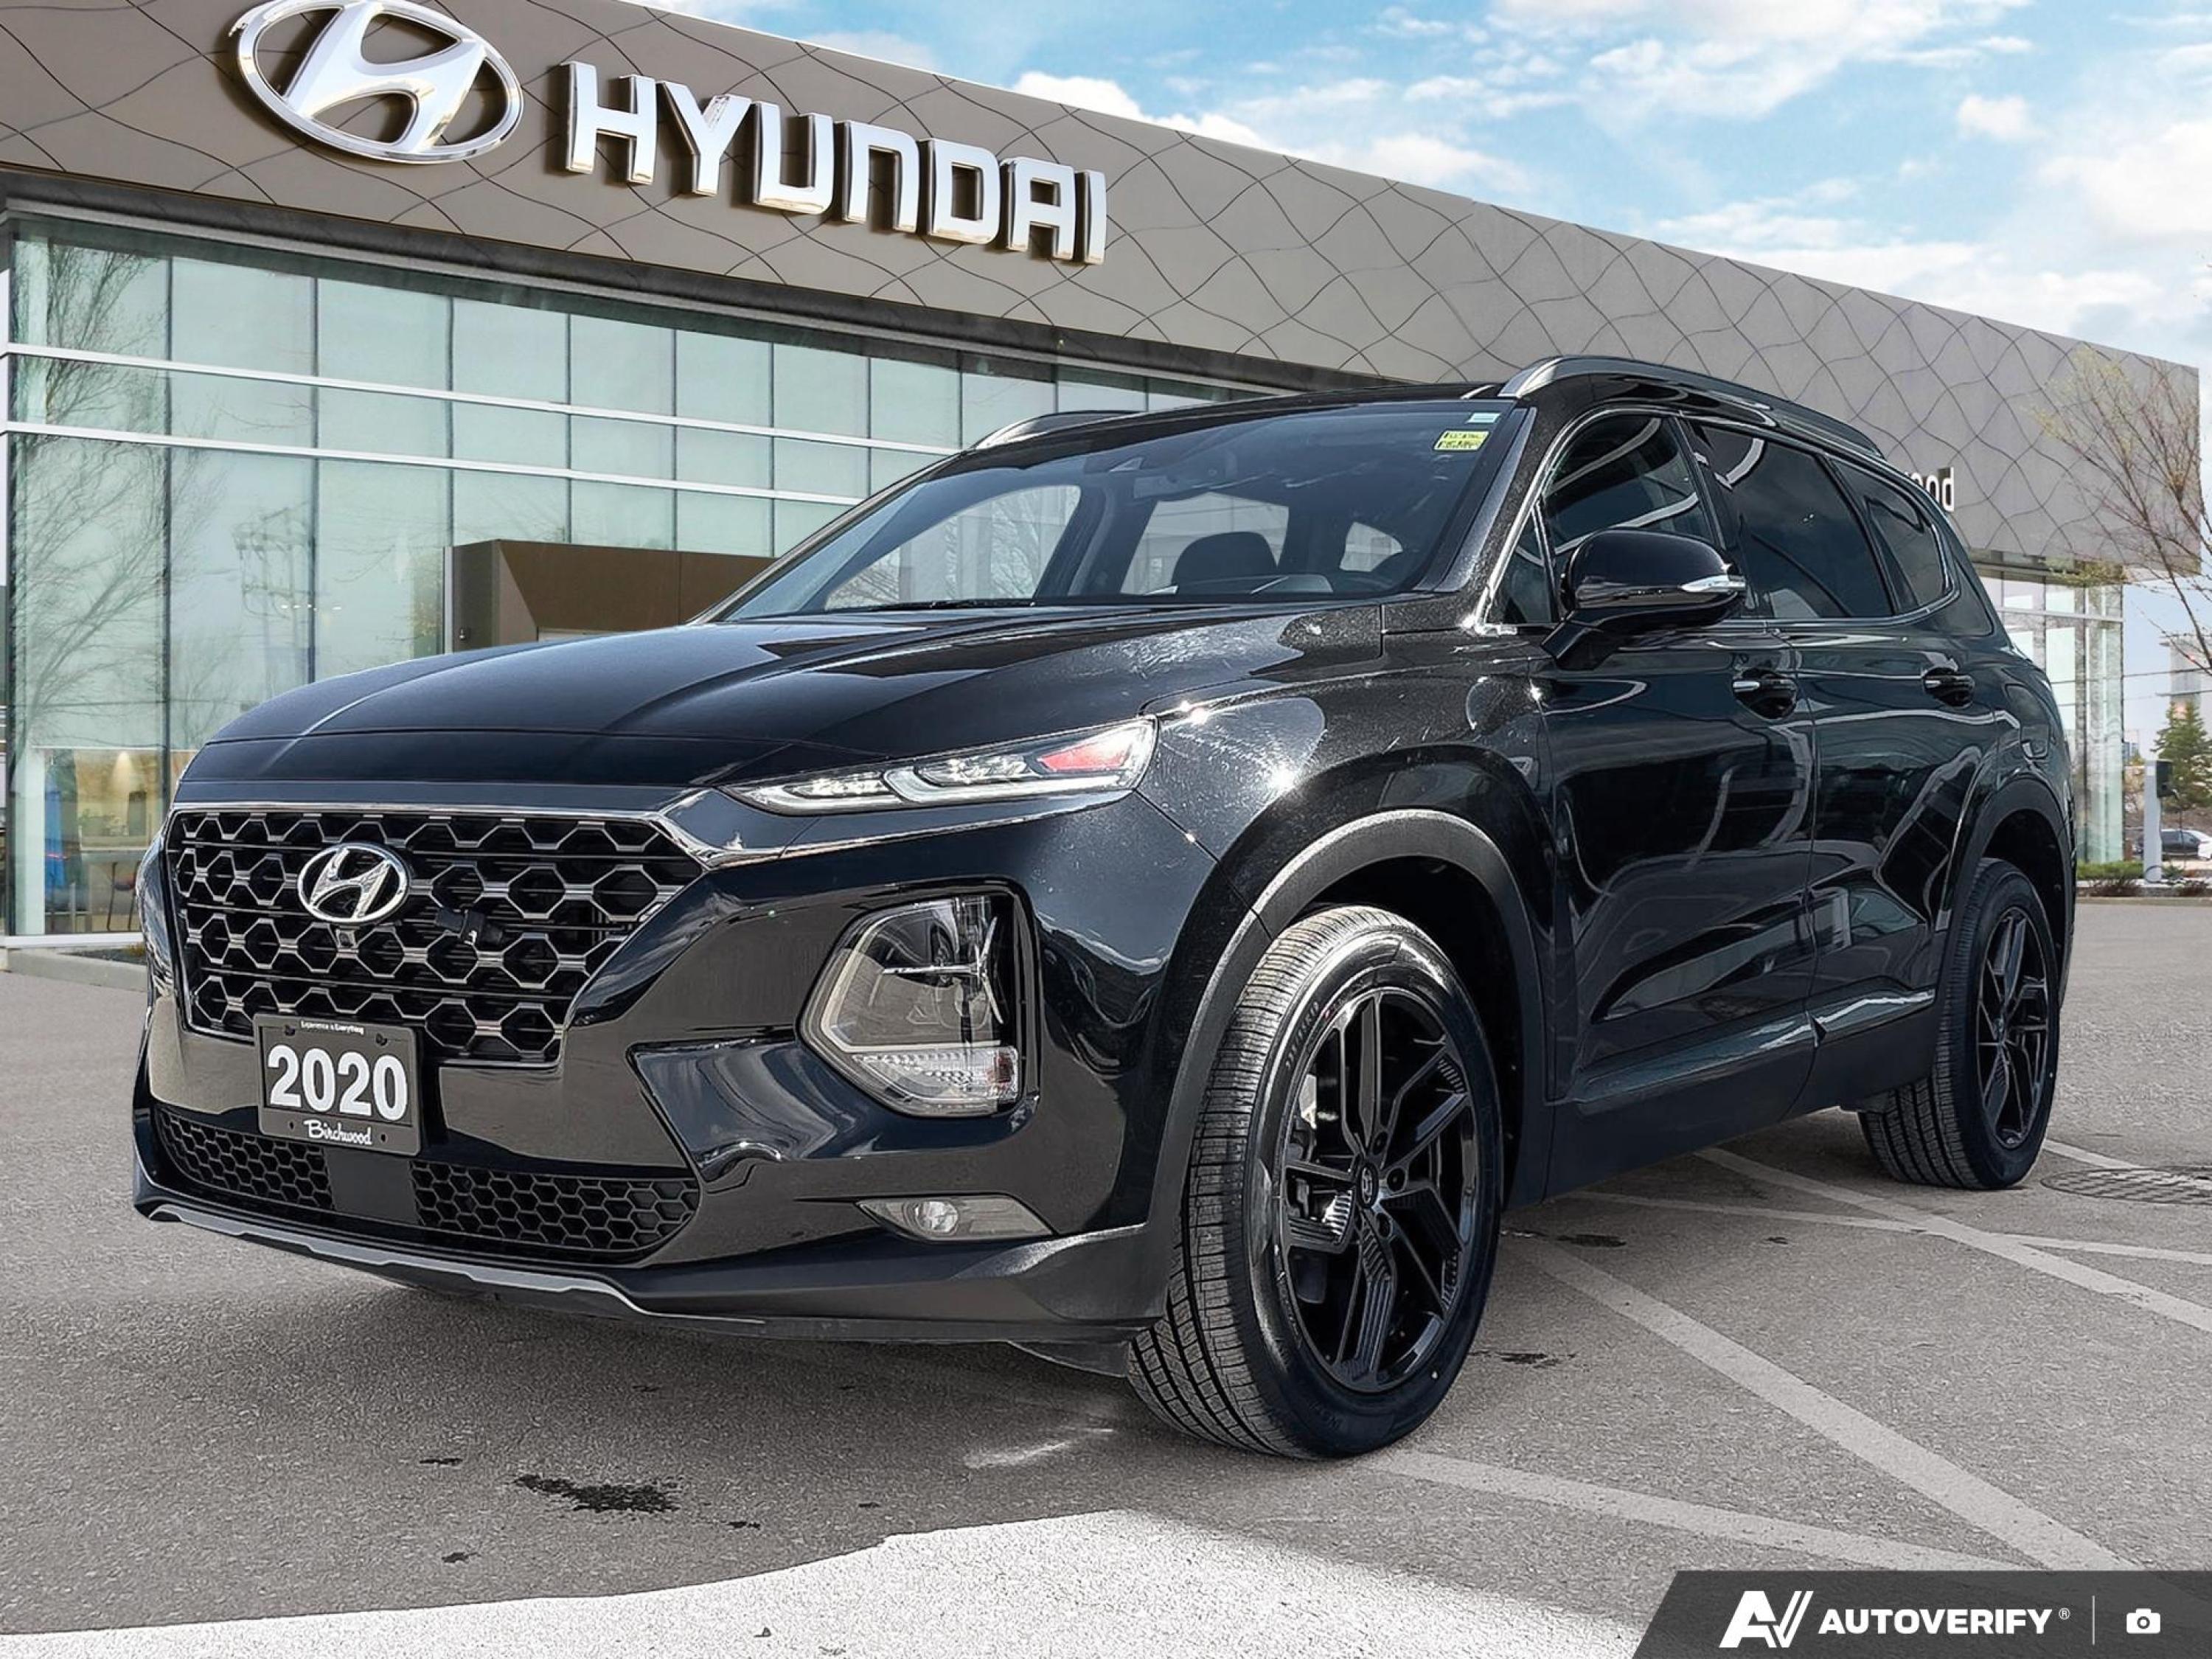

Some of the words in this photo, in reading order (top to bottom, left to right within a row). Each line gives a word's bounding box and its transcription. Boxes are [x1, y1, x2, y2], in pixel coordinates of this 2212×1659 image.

[560, 60, 1107, 265] HYUNDAI
[268, 1044, 408, 1121] 2020
[303, 1119, 372, 1145] Birchwood
